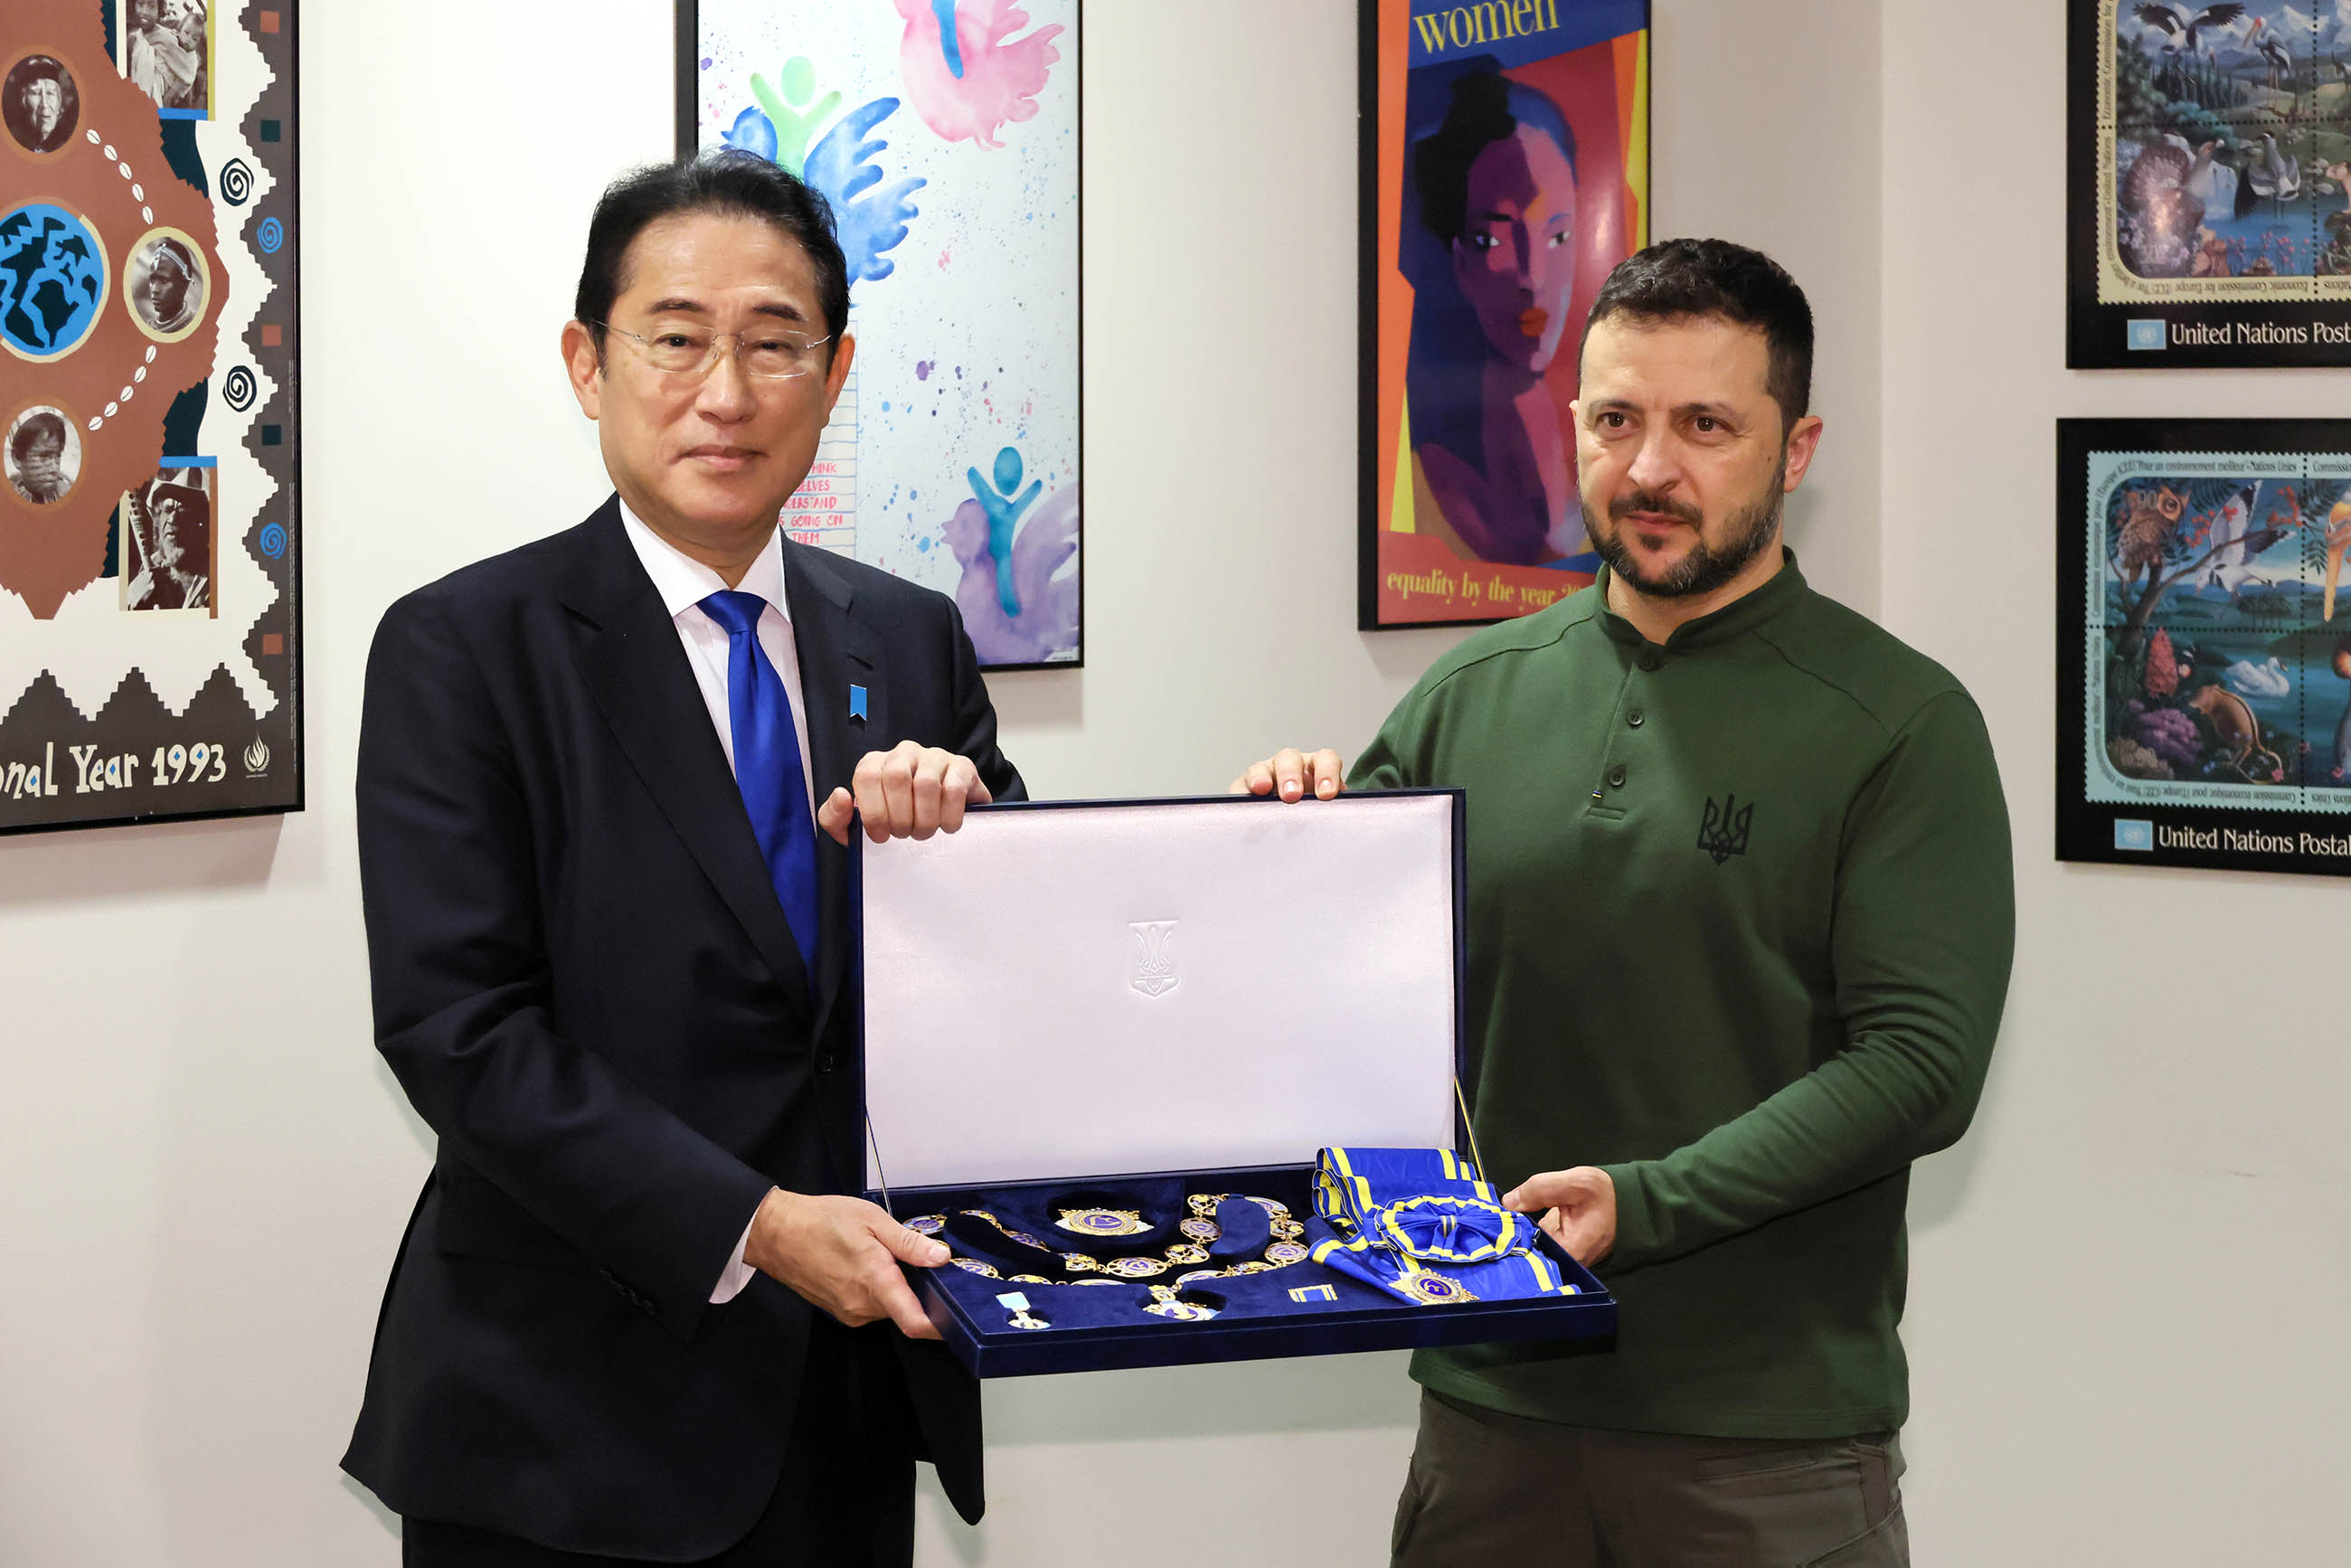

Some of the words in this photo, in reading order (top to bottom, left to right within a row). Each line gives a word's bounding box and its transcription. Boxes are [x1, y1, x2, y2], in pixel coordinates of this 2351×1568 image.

[1413, 0, 1561, 54] women
[2172, 322, 2231, 345] United
[2237, 321, 2308, 344] Nations
[2313, 322, 2351, 344] Post
[811, 462, 837, 474] HINK
[790, 514, 820, 527] GOING
[792, 532, 820, 545] THEM
[1386, 569, 1459, 606] equality
[1462, 571, 1481, 607] by
[1487, 575, 1514, 602] the
[1519, 584, 1556, 612] year
[0, 741, 58, 799] nal
[69, 744, 139, 794] Year
[152, 742, 226, 786] 1993
[2158, 825, 2218, 849] United
[2224, 829, 2295, 853] Nations
[2299, 832, 2351, 856] Postal
